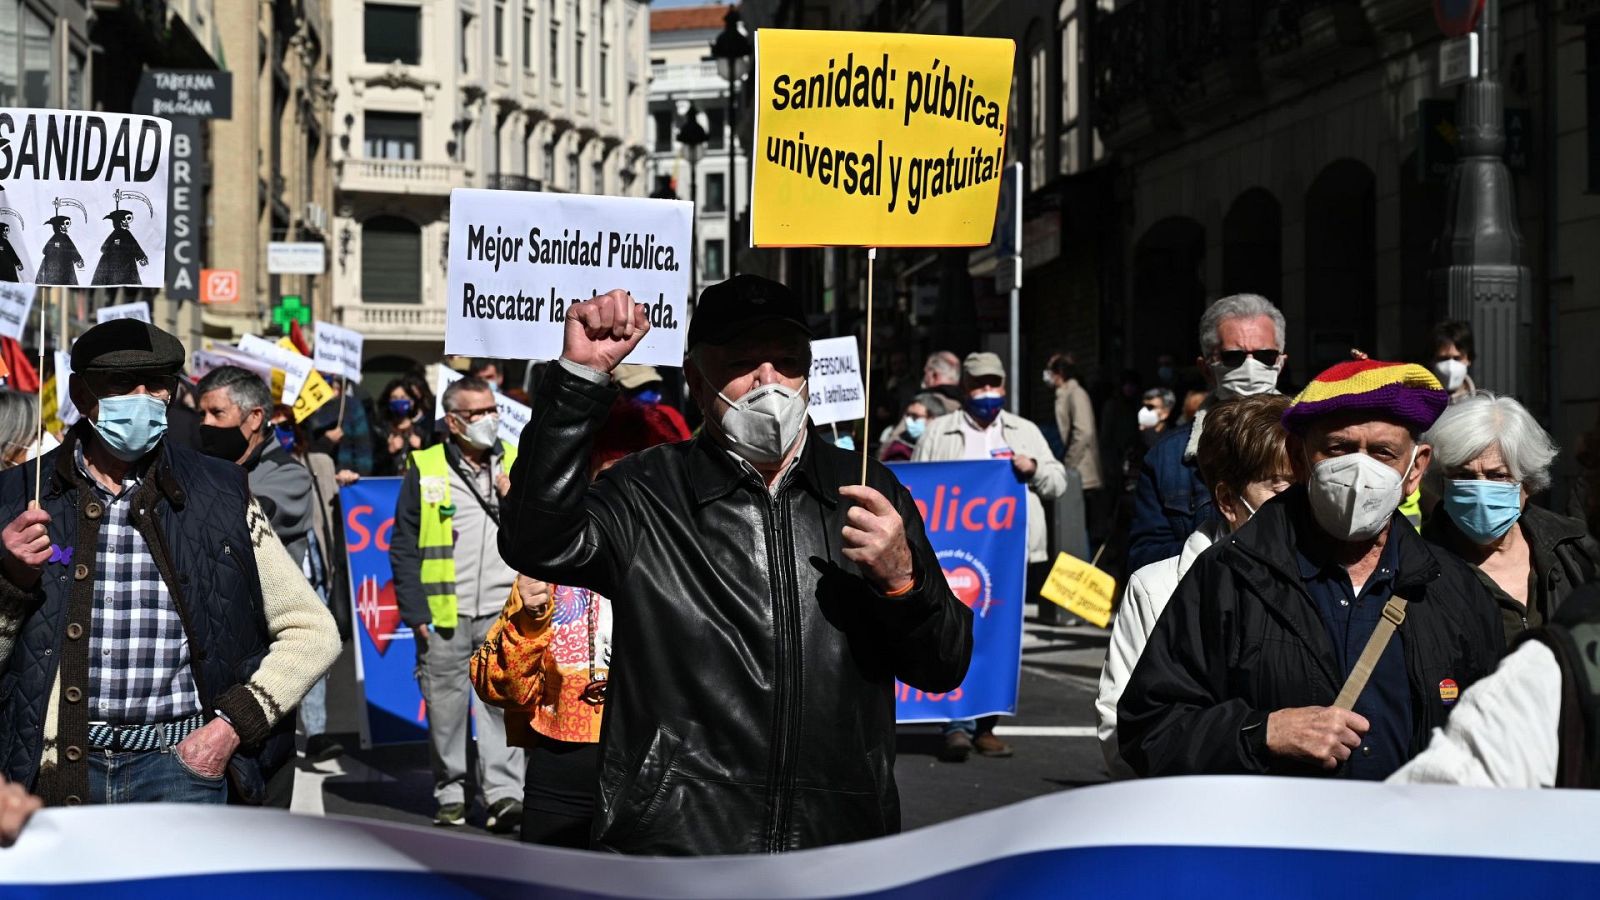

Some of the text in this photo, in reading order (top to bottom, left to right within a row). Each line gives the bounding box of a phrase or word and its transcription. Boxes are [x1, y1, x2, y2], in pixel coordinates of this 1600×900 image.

[772, 53, 1005, 137] Sanidad: pública,
[0, 113, 162, 182] SANIDAD
[766, 132, 1002, 215] universal y gratuita!
[173, 133, 193, 290] BRESCA
[467, 224, 679, 272] Mejor Sanidad Pública.
[462, 283, 544, 321] Rescatar
[549, 287, 565, 322] la
